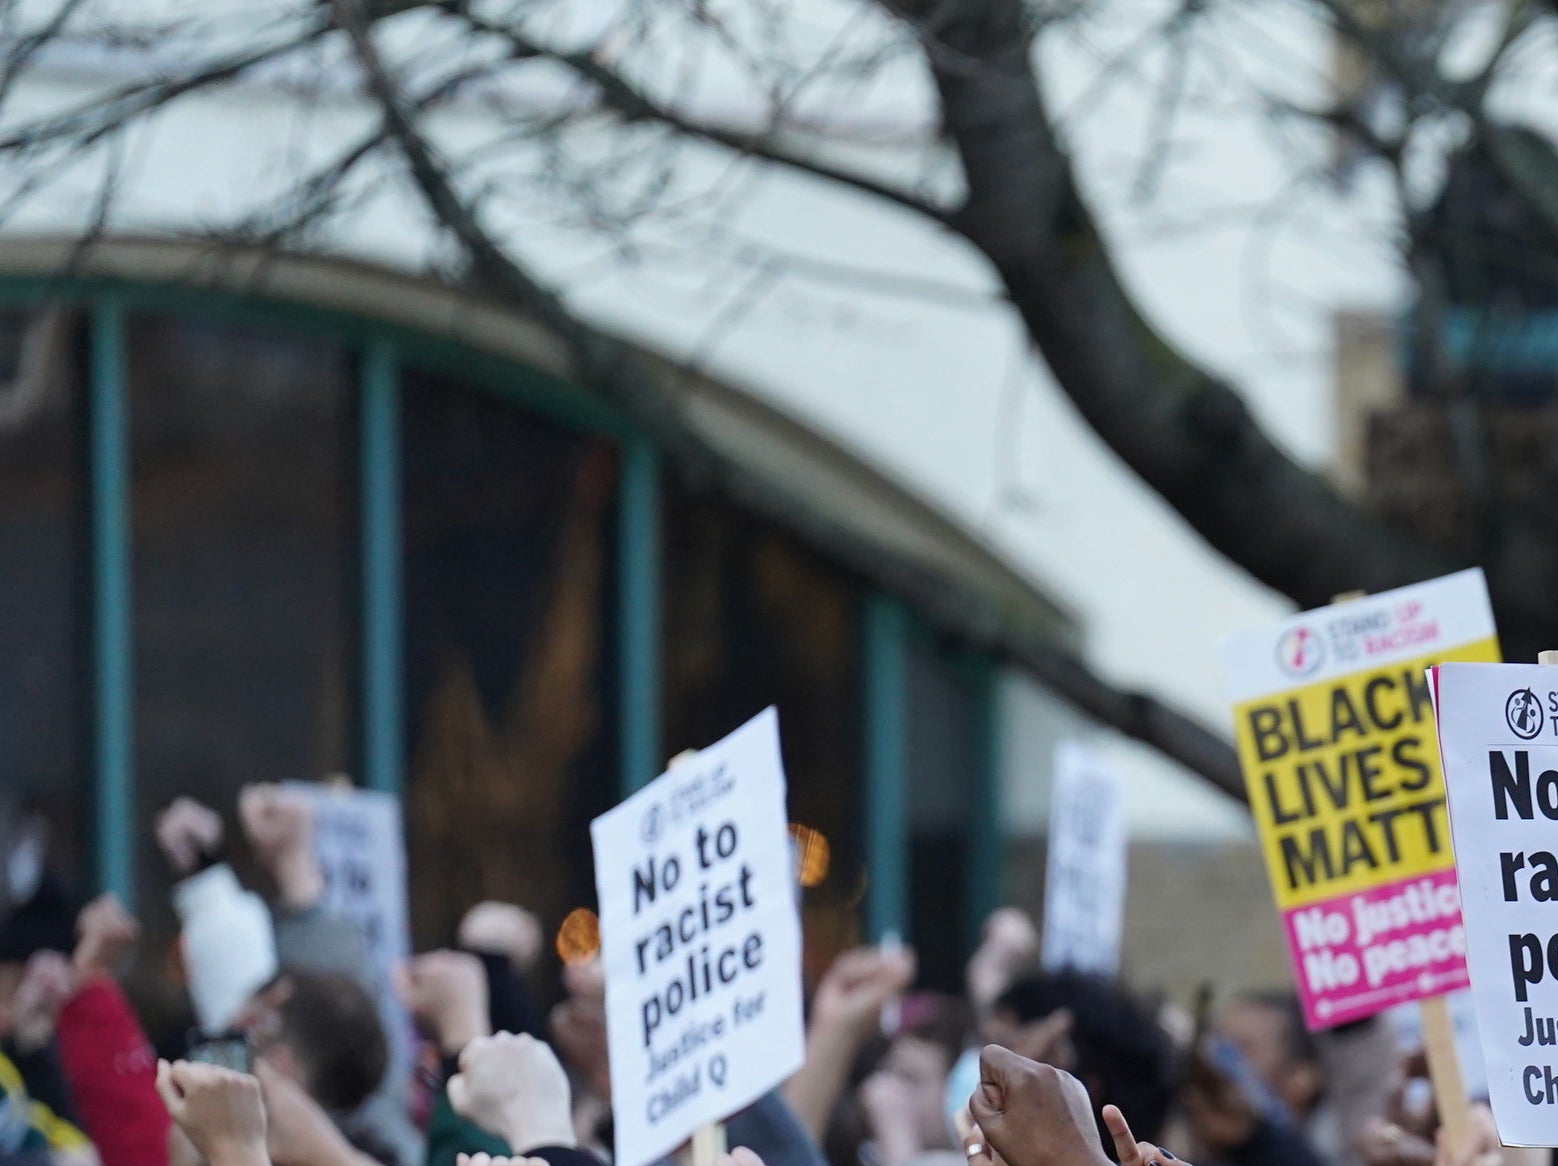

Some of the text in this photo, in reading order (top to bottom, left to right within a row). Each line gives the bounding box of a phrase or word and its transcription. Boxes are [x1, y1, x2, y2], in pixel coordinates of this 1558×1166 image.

[1263, 736, 1431, 825] LIVES
[632, 821, 738, 917] No to
[635, 861, 756, 976] racist
[1293, 907, 1350, 951] No
[641, 930, 764, 1046] police
[1304, 949, 1361, 994] No
[645, 992, 765, 1084] Justice for
[647, 1053, 727, 1124] Child Q
